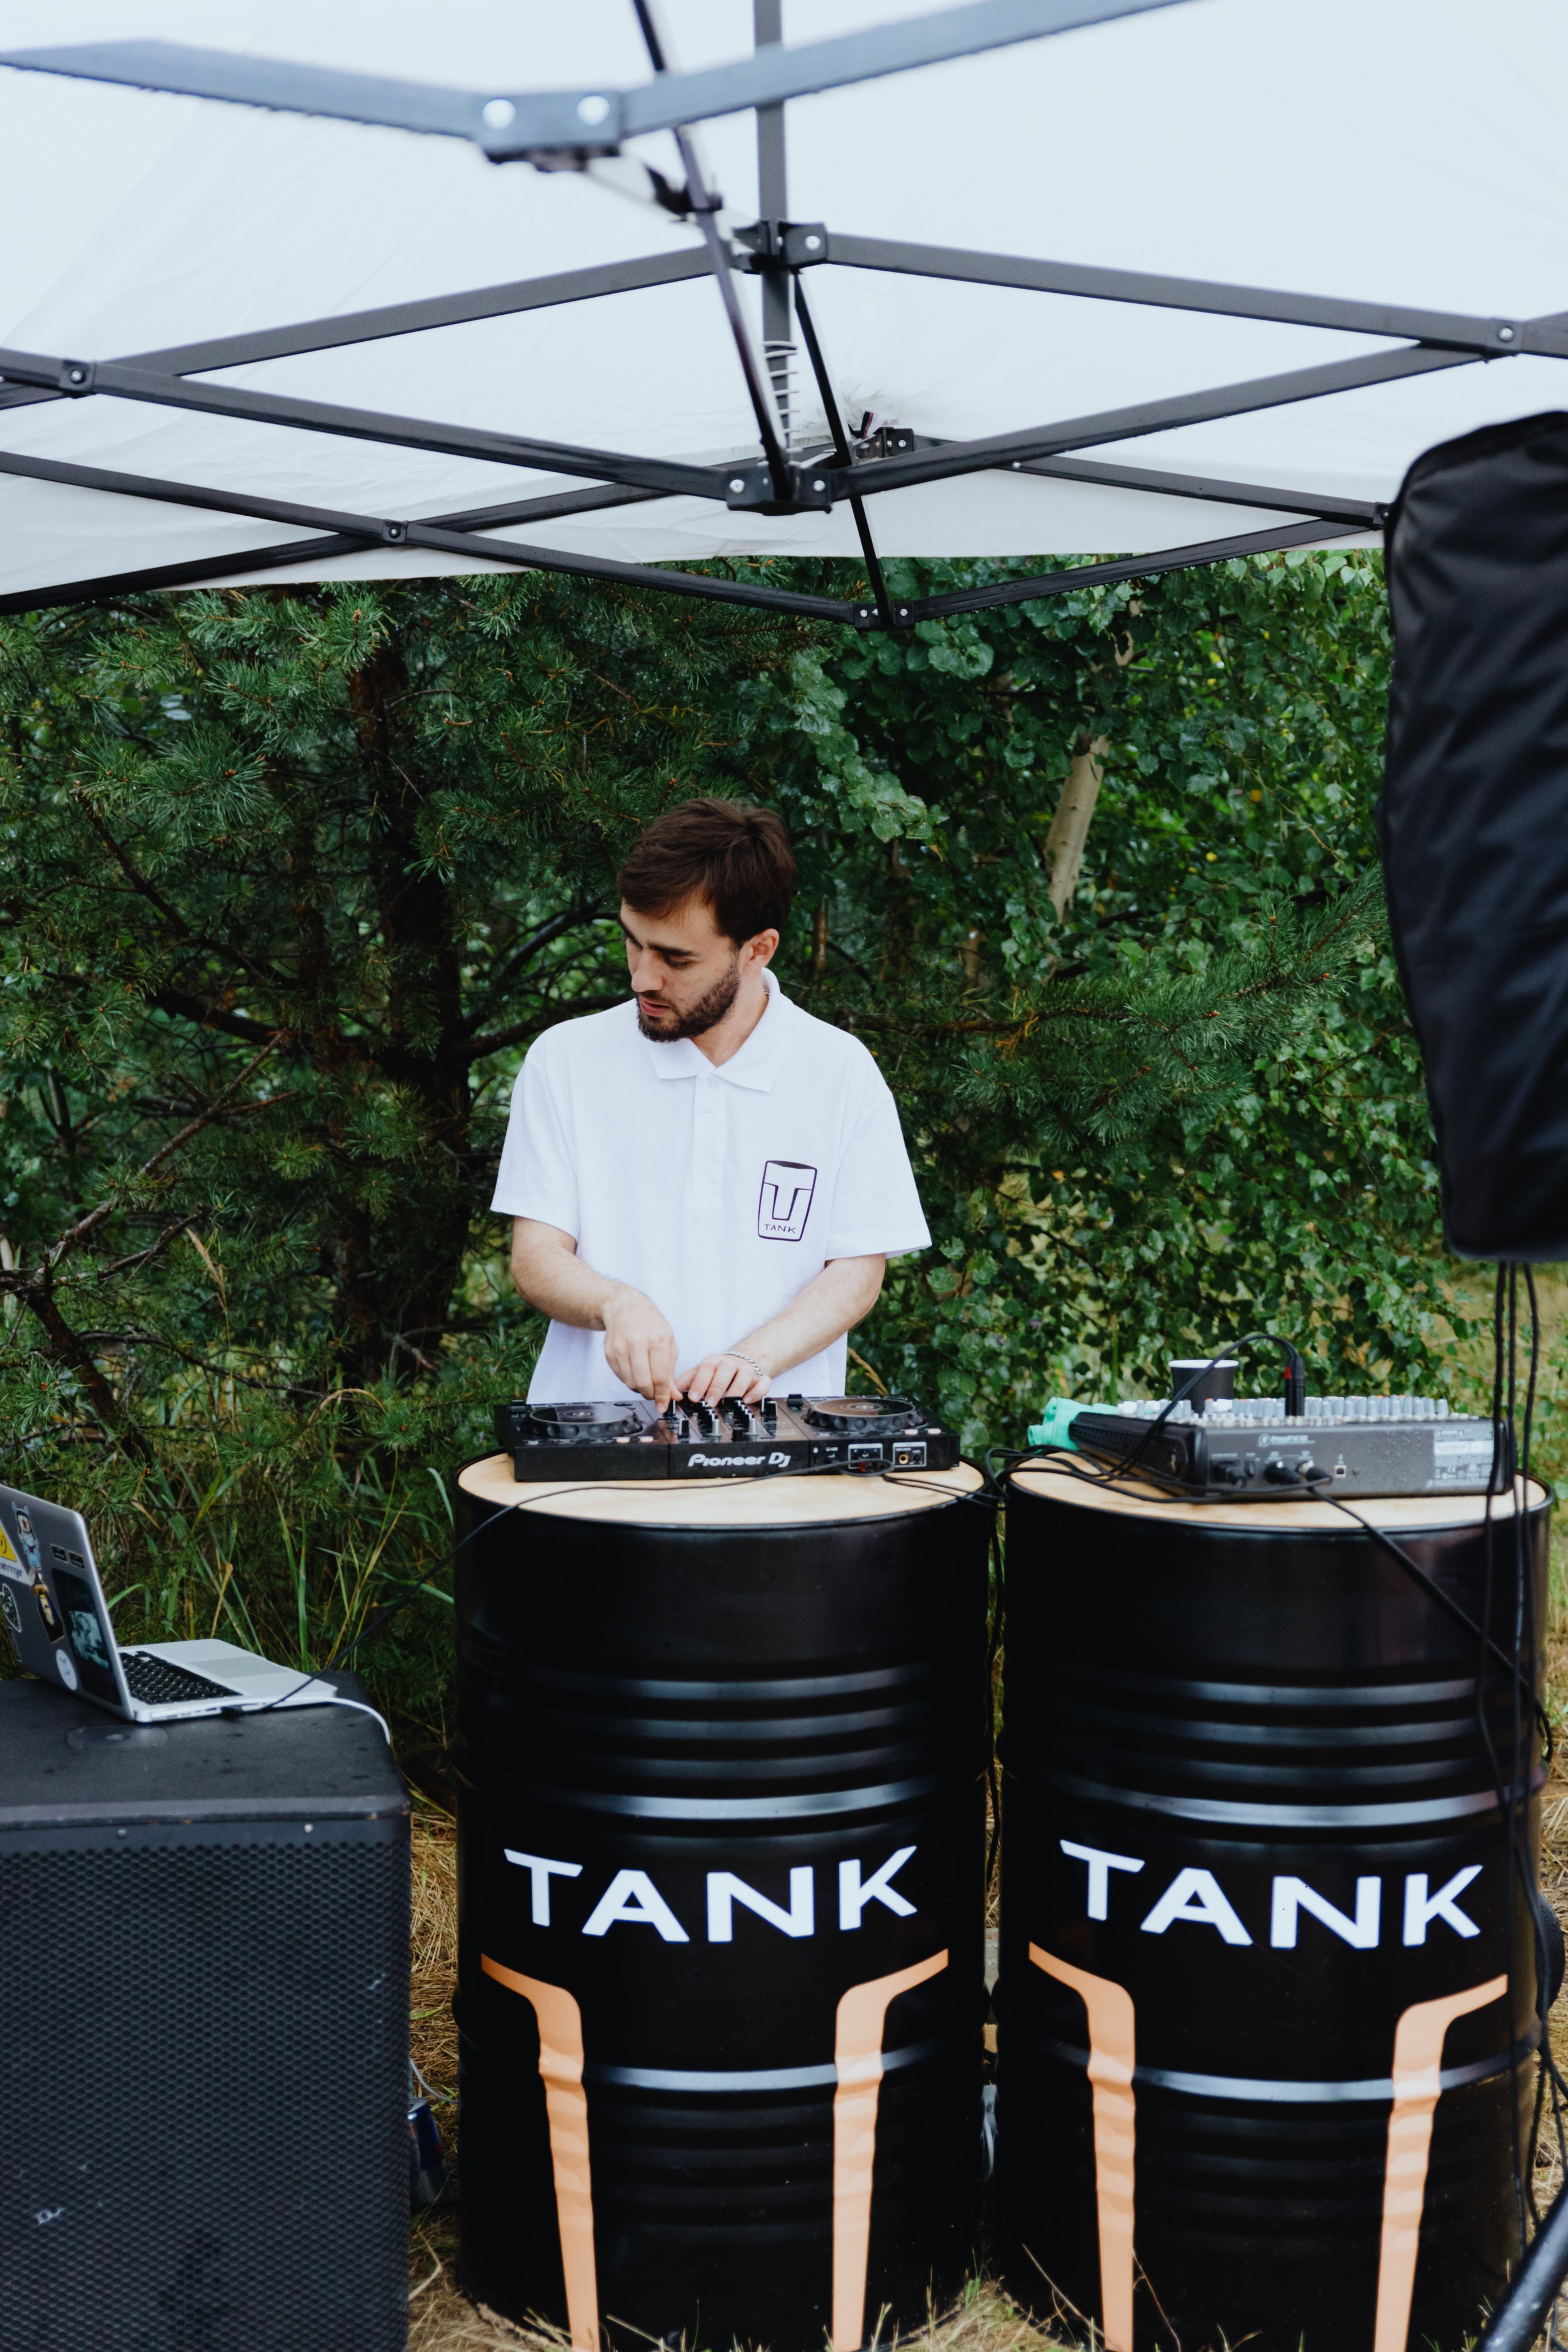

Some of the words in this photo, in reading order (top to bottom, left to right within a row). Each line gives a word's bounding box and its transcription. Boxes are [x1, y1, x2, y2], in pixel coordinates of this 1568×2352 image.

[764, 1224, 796, 1234] TANK
[687, 1453, 766, 1467] Pioneer
[504, 1845, 918, 1942] TANK
[1060, 1839, 1483, 1948] TANK
